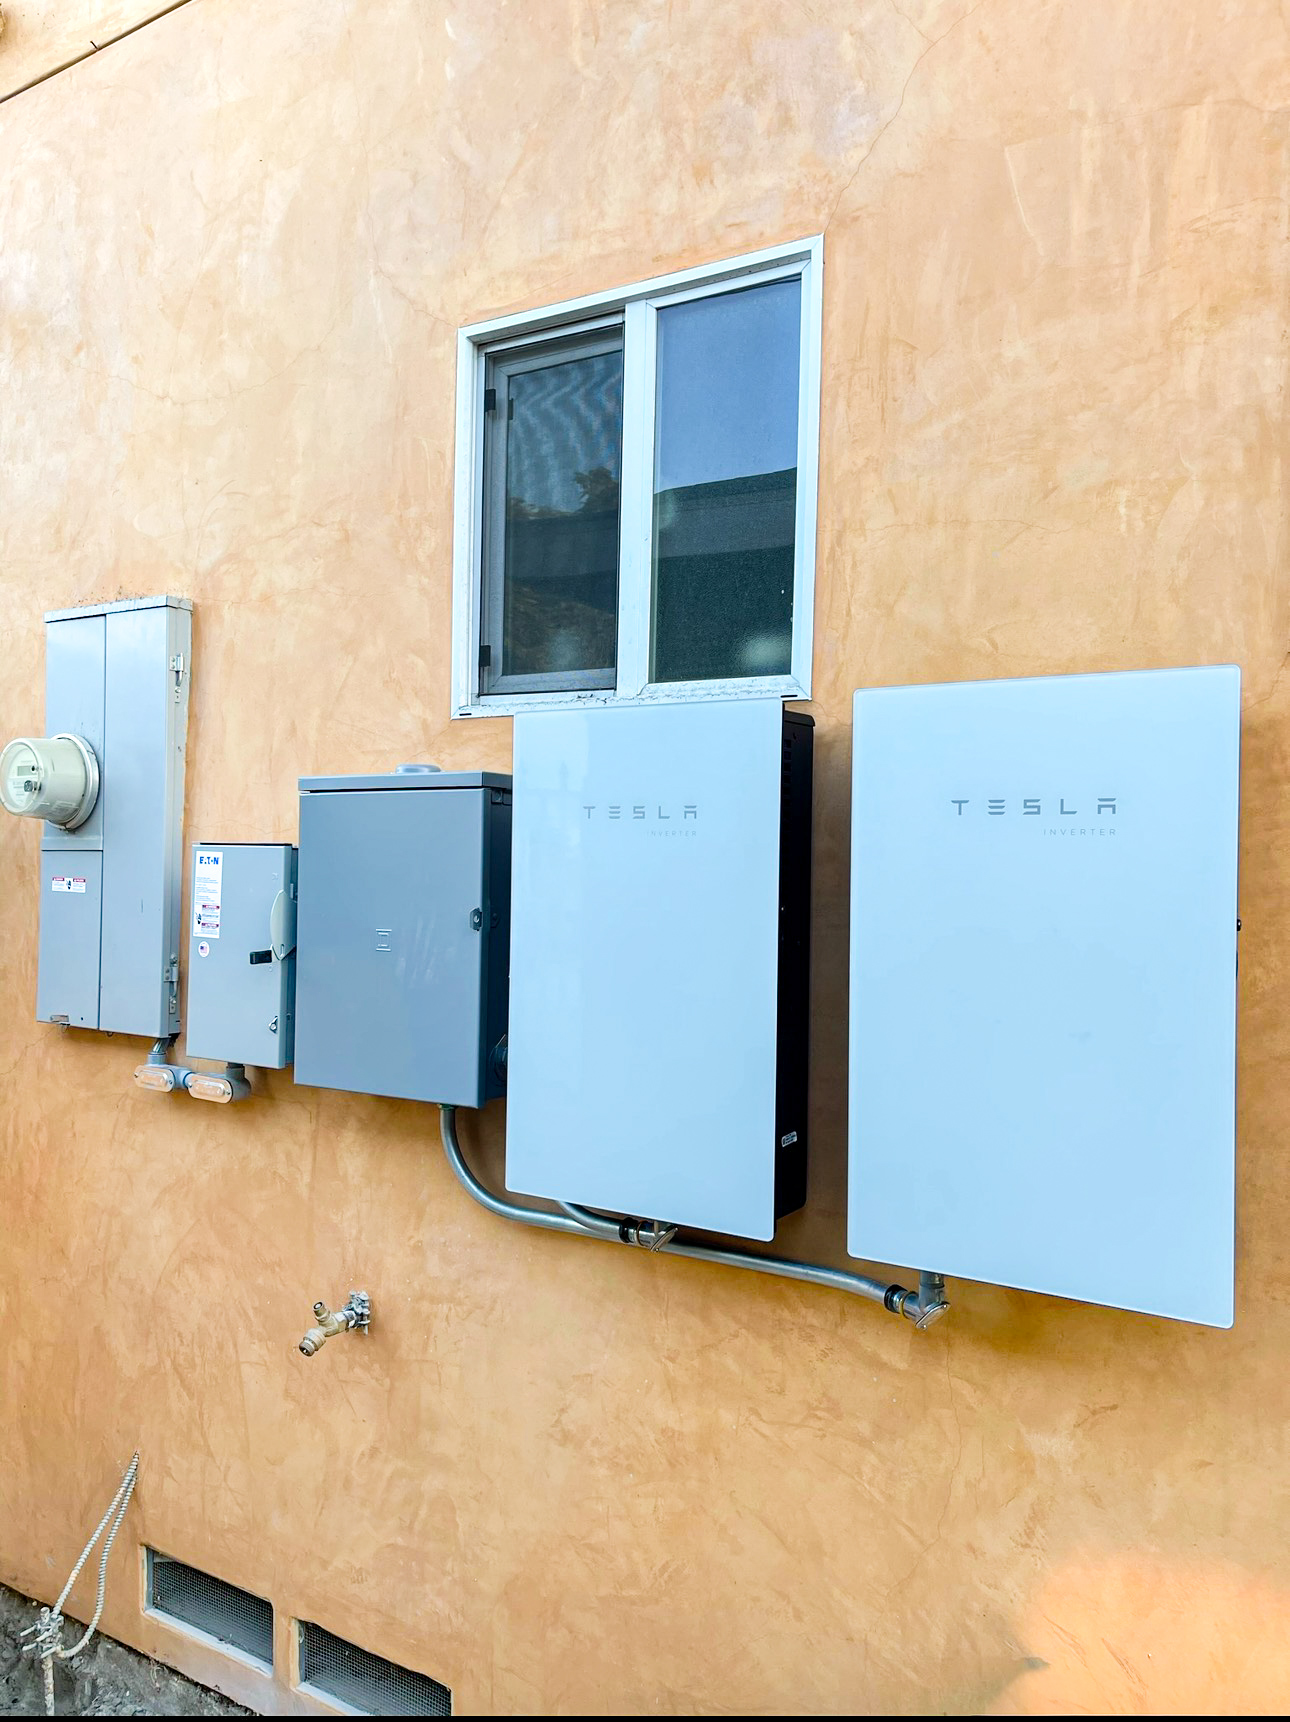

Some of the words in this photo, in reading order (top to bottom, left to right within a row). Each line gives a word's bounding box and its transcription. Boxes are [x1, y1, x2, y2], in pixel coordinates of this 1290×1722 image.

[583, 805, 698, 819] TESLA
[951, 798, 1117, 815] TESLA
[1043, 828, 1117, 836] INVERTER
